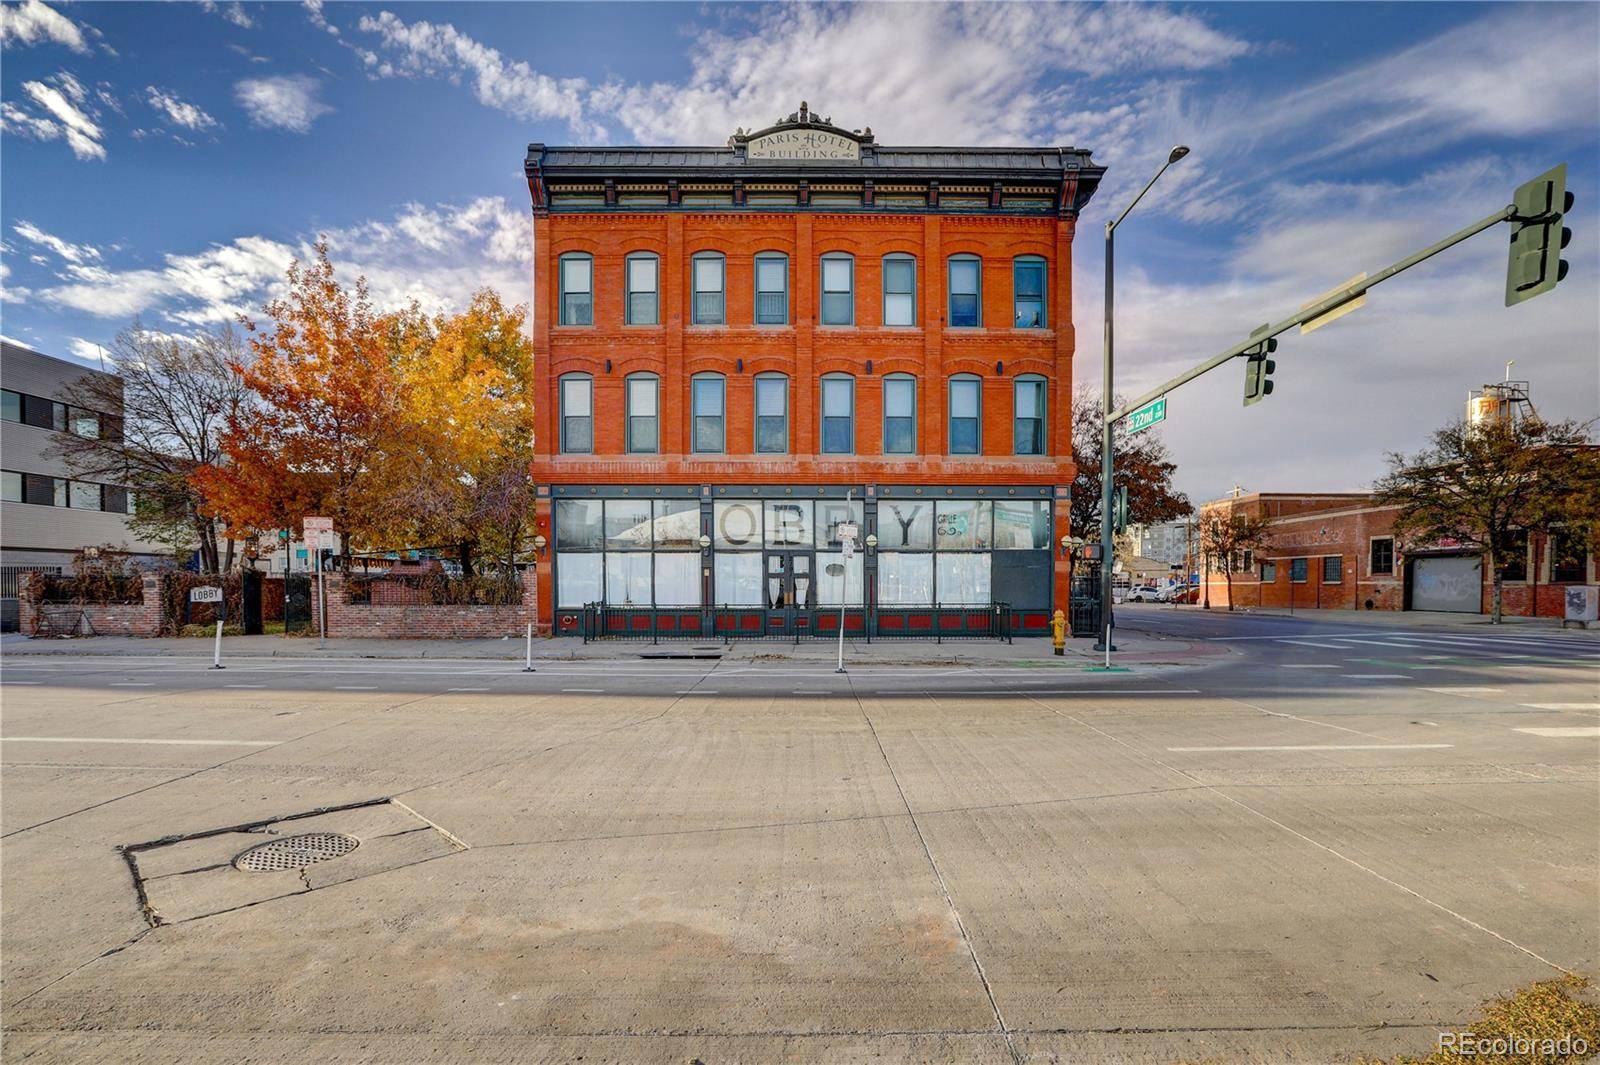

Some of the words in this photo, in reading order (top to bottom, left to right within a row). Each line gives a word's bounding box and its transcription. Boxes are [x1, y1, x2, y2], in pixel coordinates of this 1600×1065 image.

[759, 133, 799, 149] PARIS
[804, 133, 854, 151] HOTEL
[769, 150, 838, 158] BUILDING
[1135, 407, 1154, 427] 22nd
[193, 589, 218, 600] LOBBY
